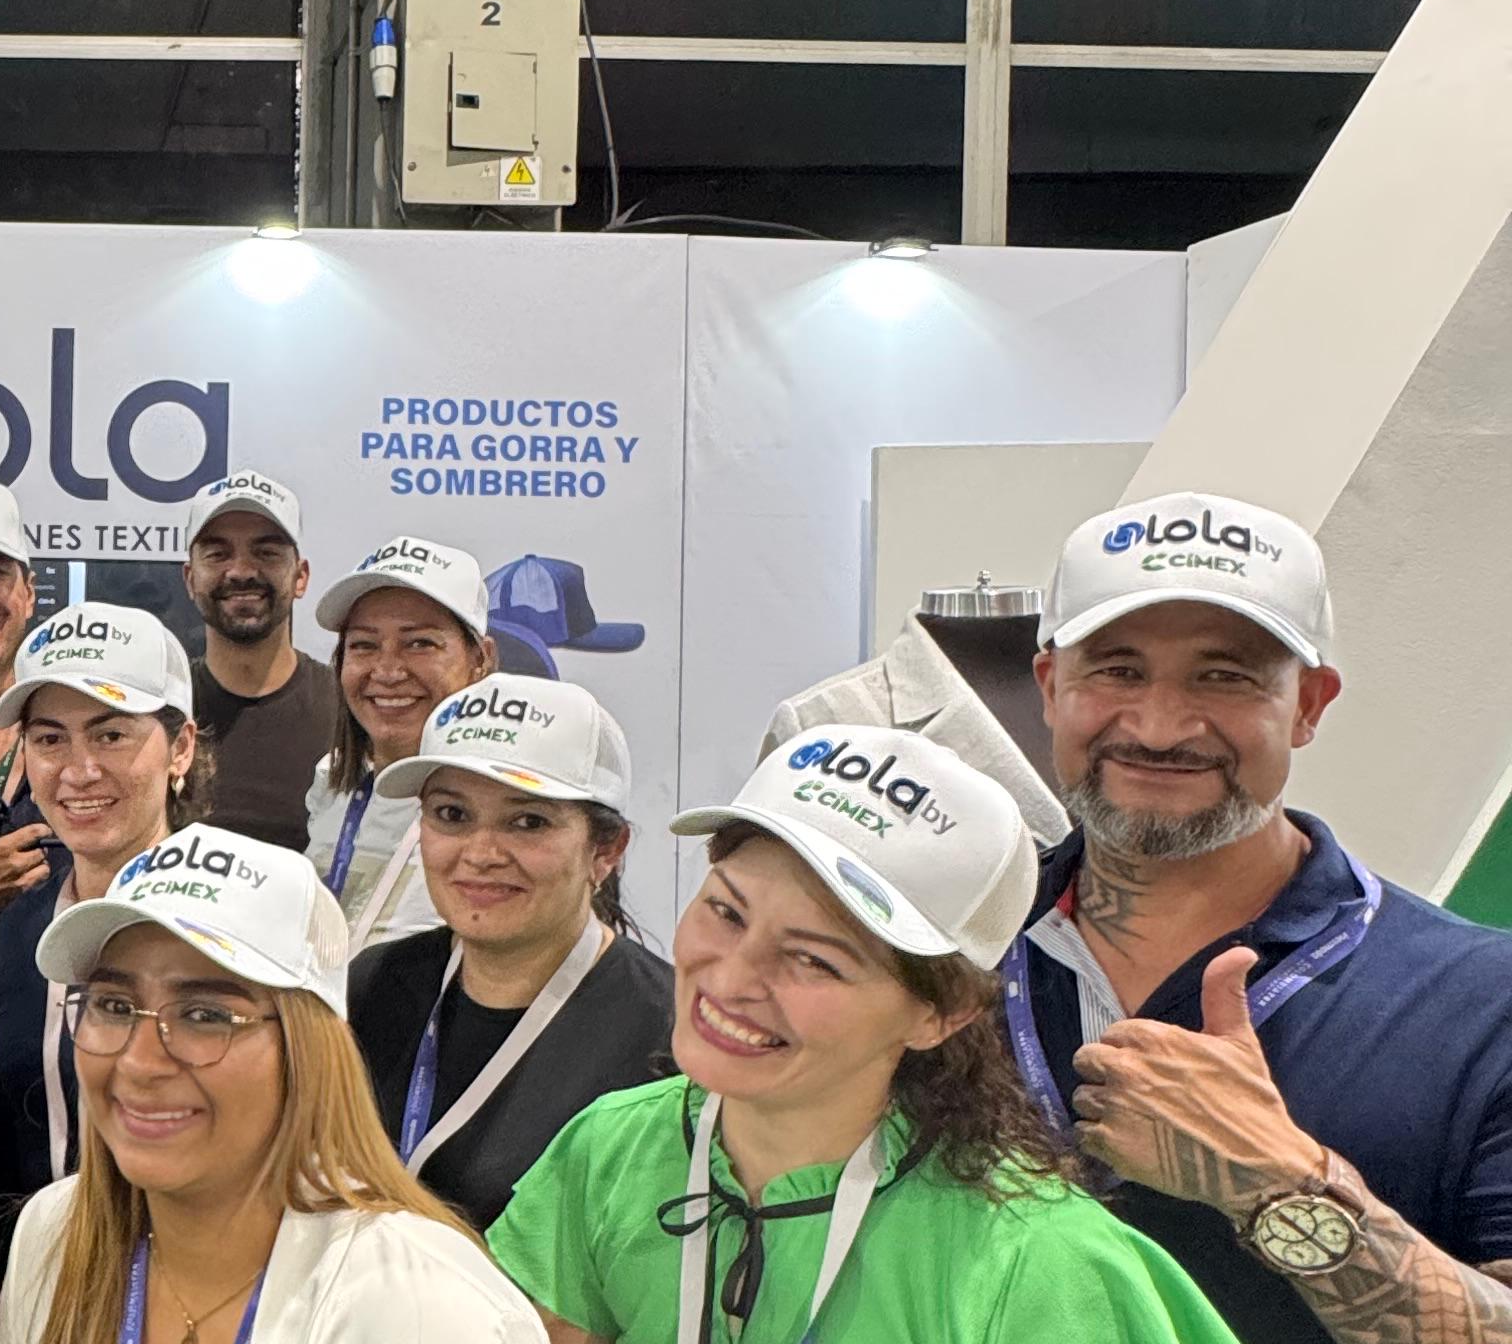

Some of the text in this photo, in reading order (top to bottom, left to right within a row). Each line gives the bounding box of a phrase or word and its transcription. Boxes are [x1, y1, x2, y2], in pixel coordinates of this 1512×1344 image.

[480, 1, 501, 26] 2
[382, 397, 618, 428] PRODUCTOS
[360, 432, 639, 463] PARA GORRA Y
[390, 467, 606, 498] SOMBRERO
[374, 539, 429, 563] lola
[1146, 509, 1283, 562] lola by
[48, 613, 108, 644] lola
[455, 687, 555, 728] lola by
[819, 739, 957, 835] lola by
[144, 835, 268, 889] lola by
